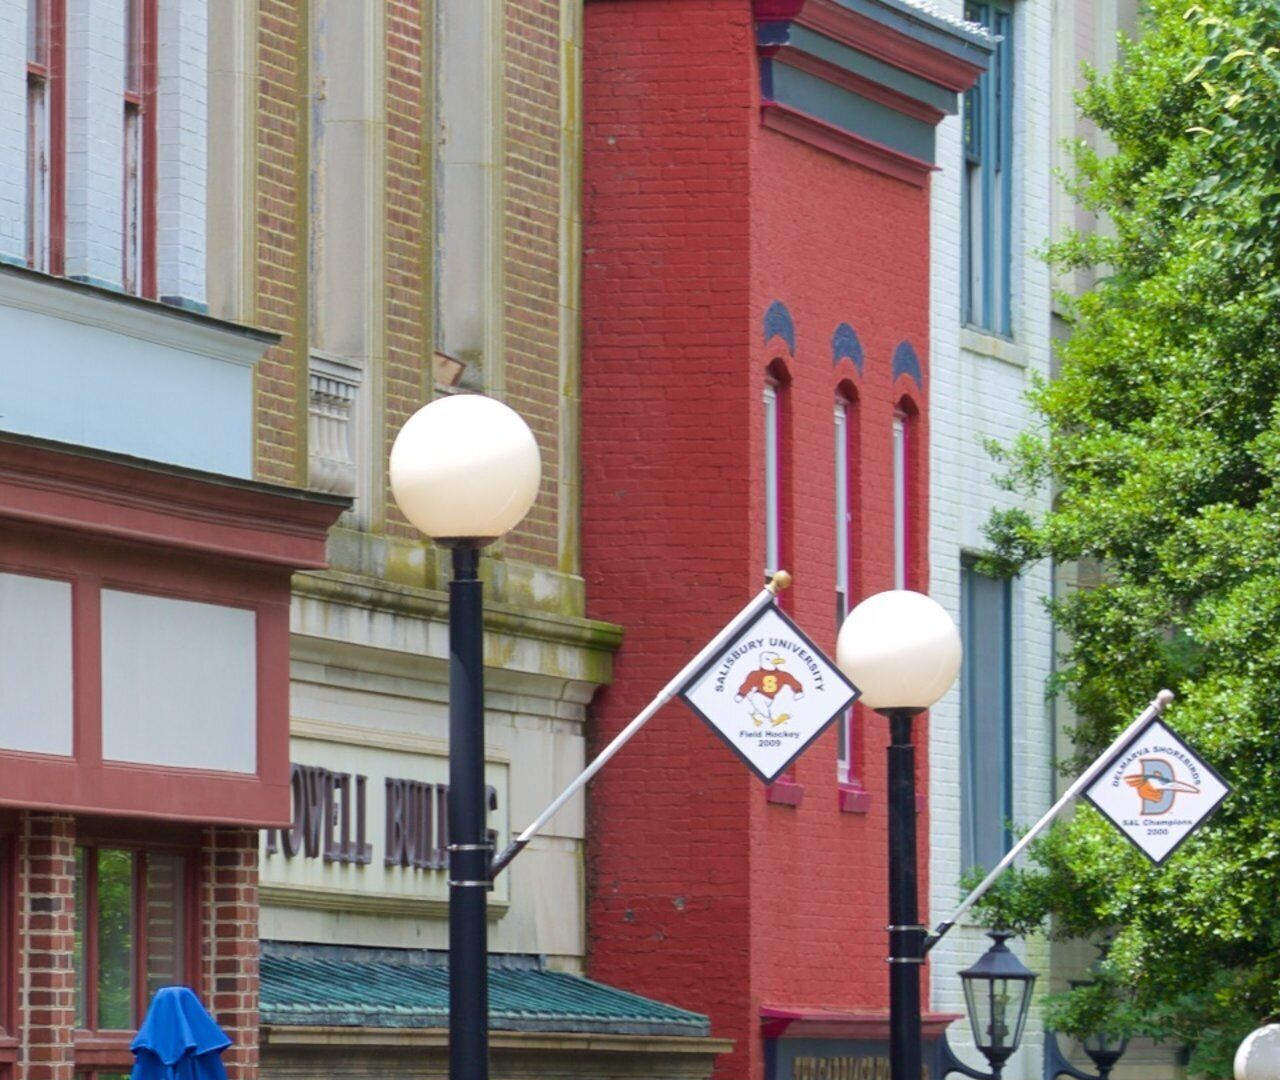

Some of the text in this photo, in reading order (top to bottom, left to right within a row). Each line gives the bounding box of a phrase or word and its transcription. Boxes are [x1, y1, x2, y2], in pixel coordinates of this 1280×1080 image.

[715, 637, 825, 692] SALISBURY UNIVERSITY
[739, 730, 763, 738] Field
[1112, 746, 1201, 787] DELMARVA SHOREBIRDS
[265, 761, 373, 865] OWELL
